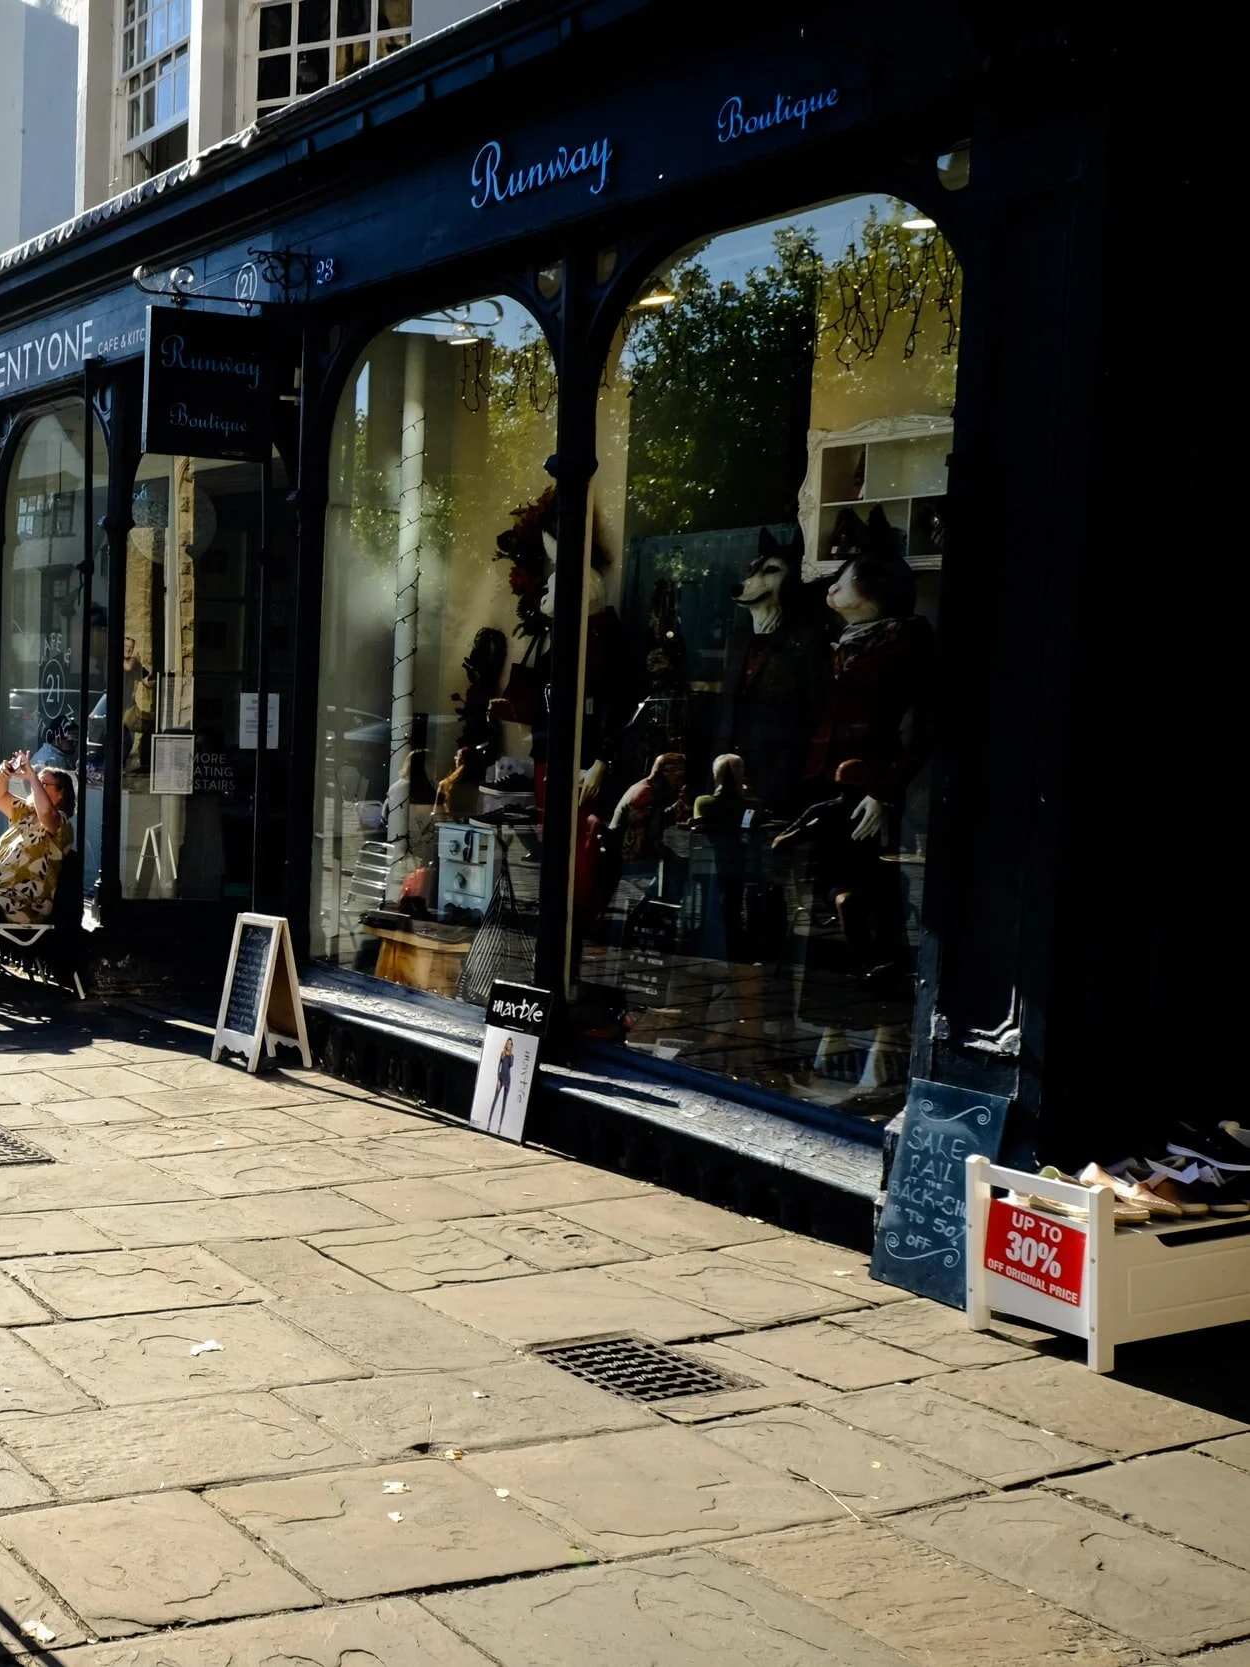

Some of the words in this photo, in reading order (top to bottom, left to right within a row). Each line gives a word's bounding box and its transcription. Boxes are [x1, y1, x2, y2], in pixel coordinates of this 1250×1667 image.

[717, 87, 839, 143] Boutique
[471, 136, 612, 208] Runway
[316, 257, 334, 285] 23
[98, 338, 118, 356] CAFE
[120, 336, 126, 348] &
[161, 334, 261, 389] Runway
[170, 402, 248, 437] Boutique
[46, 674, 60, 703] 21
[492, 998, 544, 1023] marble
[906, 1126, 966, 1160] SALE
[904, 1176, 918, 1184] AT
[909, 1154, 954, 1184] RAIL
[890, 1180, 935, 1210] BACK
[906, 1234, 933, 1250] OFF
[1011, 1211, 1035, 1231] UP
[1039, 1221, 1062, 1243] TO
[1005, 1230, 1062, 1278] 30%
[988, 1258, 1004, 1272] OFF
[1006, 1266, 1046, 1292] ORIGINAL
[1050, 1283, 1078, 1304] PRICE
